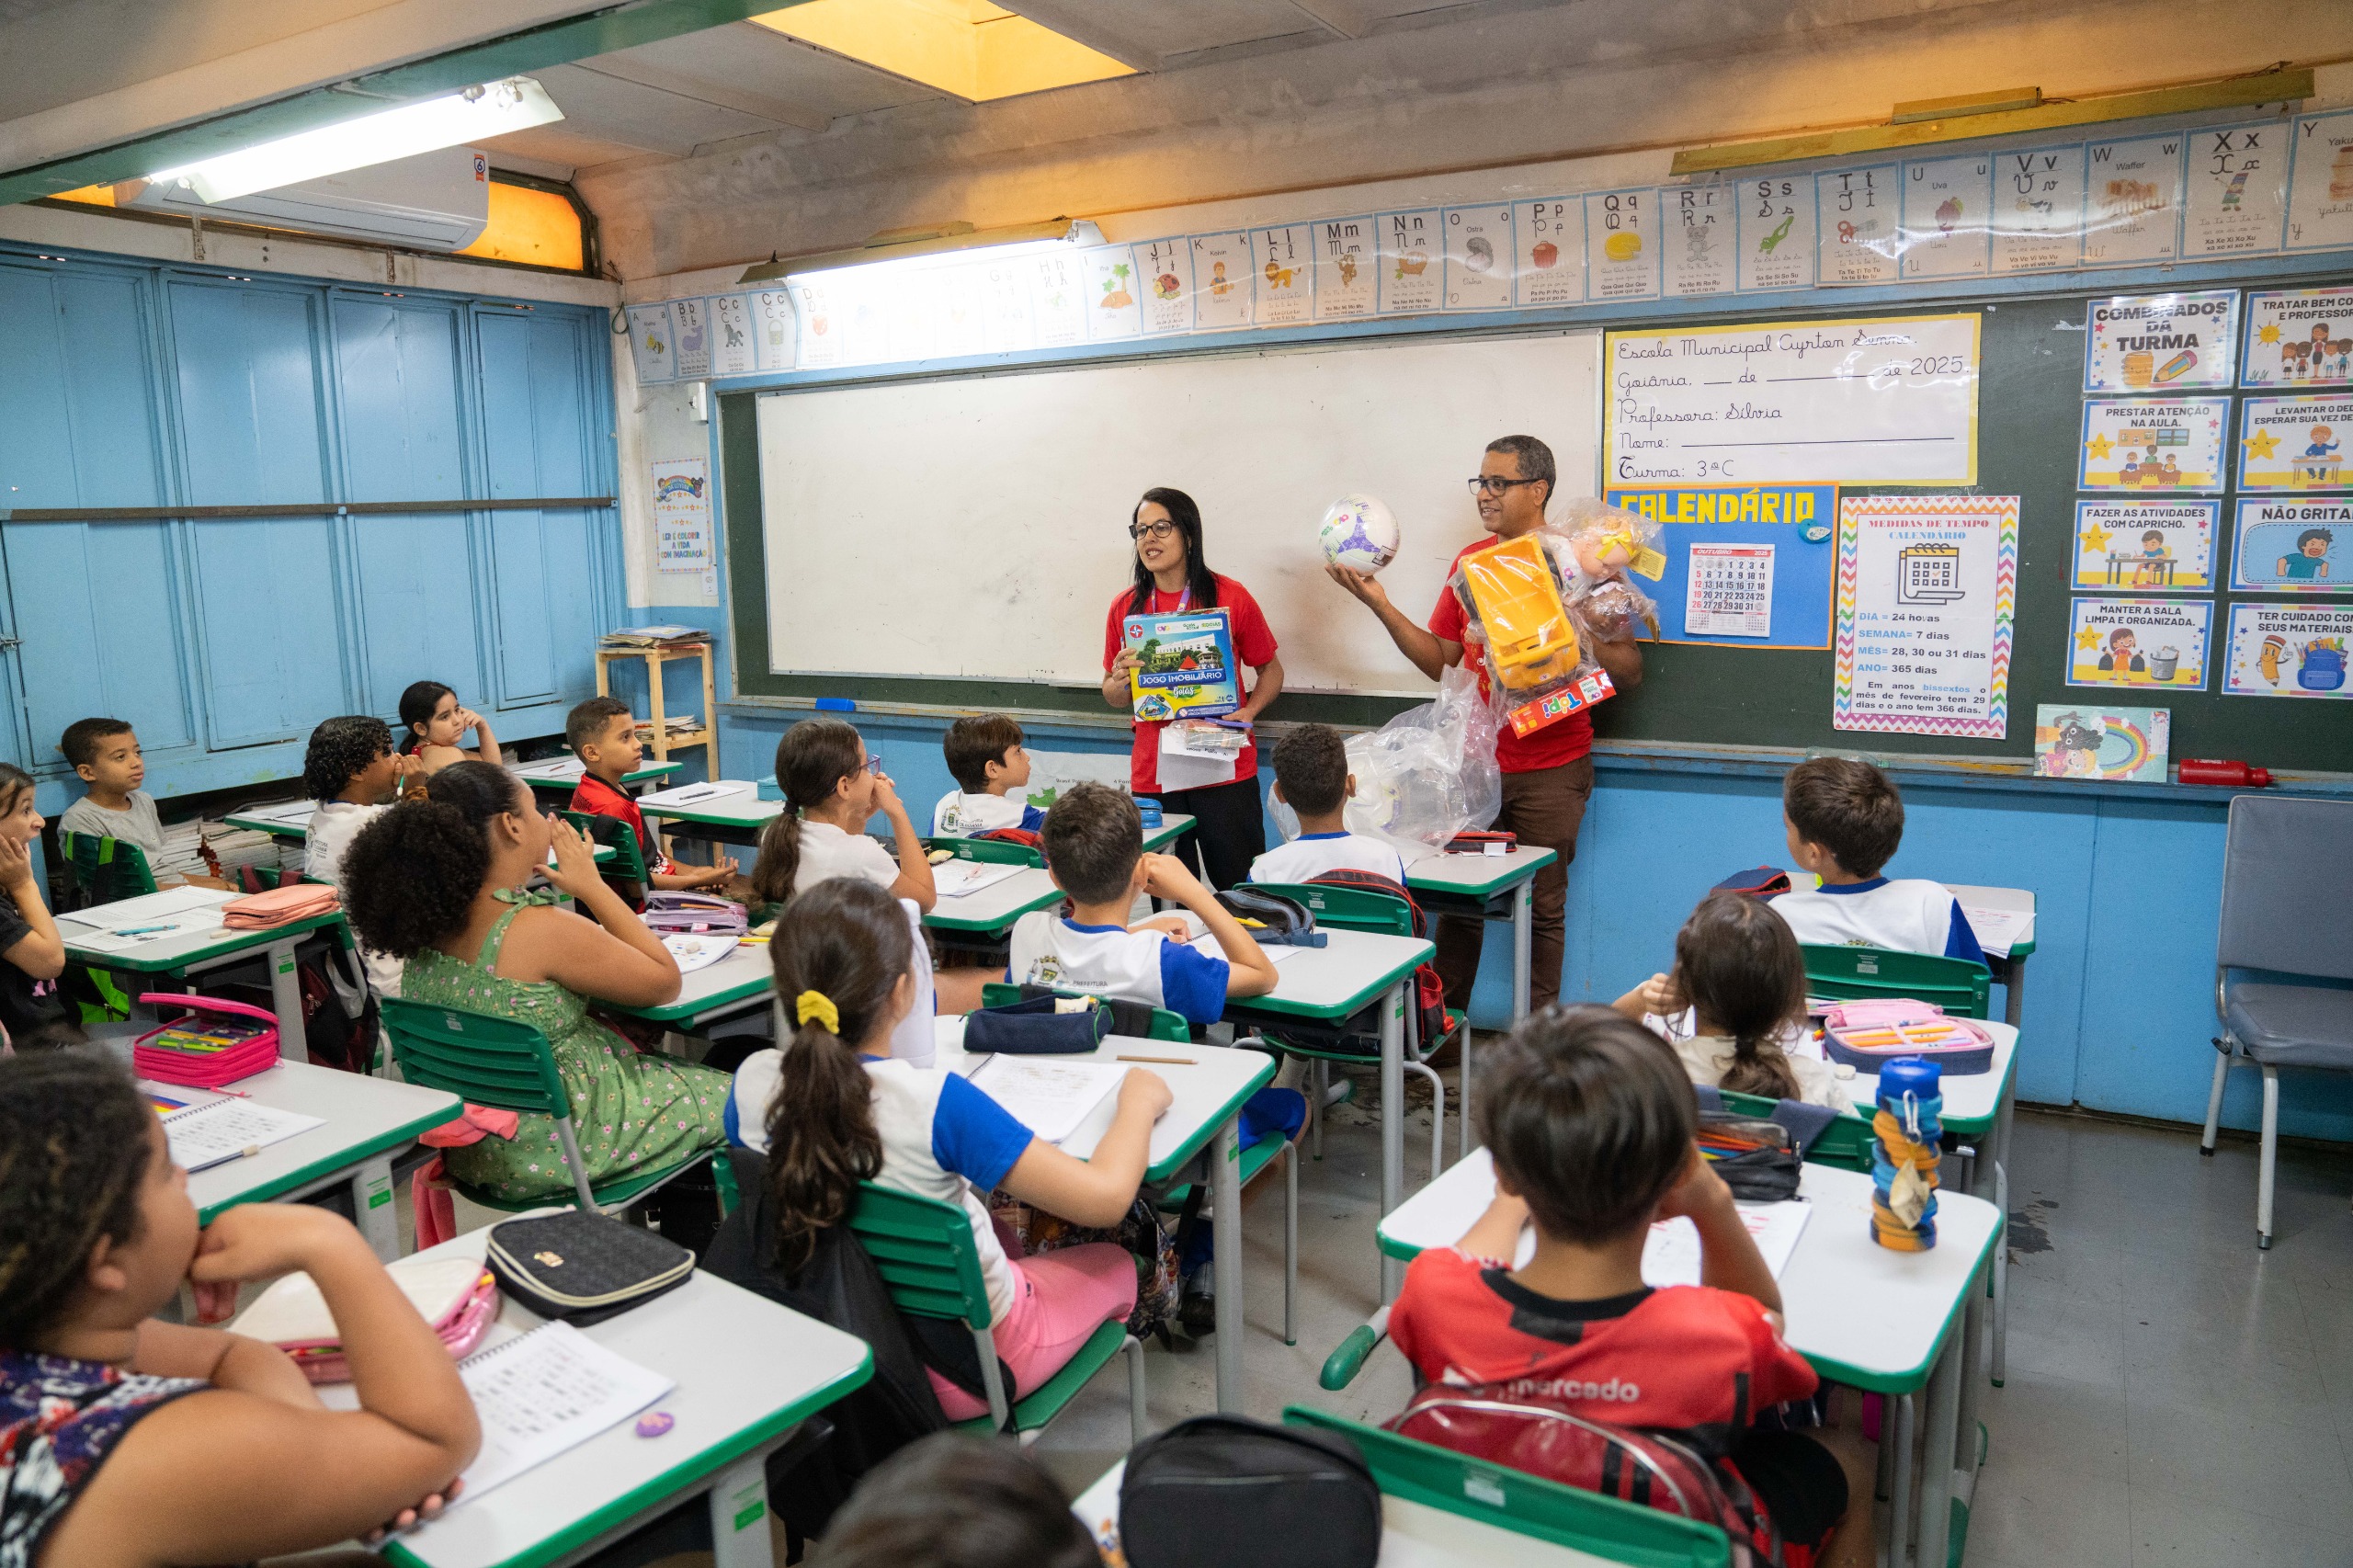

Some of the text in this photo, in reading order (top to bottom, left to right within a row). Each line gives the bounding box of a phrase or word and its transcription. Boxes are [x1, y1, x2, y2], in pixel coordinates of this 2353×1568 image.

[2303, 121, 2318, 138] Y
[2213, 131, 2259, 153] X x
[2093, 143, 2177, 163] W w
[2017, 153, 2057, 172] V v
[2116, 161, 2146, 172] Waffer
[1913, 164, 1986, 181] U u
[1838, 171, 1873, 191] T t
[1932, 182, 1948, 190] Uva
[1758, 181, 1792, 198] S s
[1605, 195, 1637, 211] Q q
[1680, 191, 1713, 207] R r
[1533, 203, 1563, 219] P p
[1393, 215, 1424, 230] N n
[1450, 212, 1508, 225] O o
[1327, 223, 1359, 238] M m
[2263, 300, 2309, 310] TRATAR
[2311, 298, 2336, 308] BEM
[2095, 301, 2229, 322] COMBINADOS
[2279, 312, 2286, 321] E
[2145, 319, 2173, 334] DA
[1619, 343, 1674, 359] Escola
[1681, 335, 1772, 361] Municipal
[2117, 333, 2200, 352] TURMA
[1738, 367, 1757, 384] de
[1883, 359, 1903, 378] de
[1618, 398, 1719, 430] Professora:
[2106, 404, 2211, 417] PRESTAR ATENÇÃO
[2275, 404, 2326, 415] LEVANTAR
[2131, 417, 2182, 428] NA AULA.
[2255, 416, 2297, 425] ESPERAR
[2321, 415, 2339, 423] VEZ
[1619, 432, 1670, 449] Nome:
[1619, 455, 1686, 481] Turma:
[1620, 487, 1814, 524] CALENDÁRIO
[2086, 508, 2206, 518] FAZER AS ATIVIDADES
[2261, 506, 2297, 520] NÃO
[1869, 520, 1990, 528] MEDIDAS DE TEMPO
[2104, 519, 2186, 529] COM CAPRICHO.
[677, 532, 700, 540] COLORIR
[1889, 530, 1966, 540] CALENDÁRIO
[1734, 602, 1744, 610] 30
[2099, 605, 2182, 616] MANTER A SALA
[1892, 613, 1905, 621] 24
[2085, 615, 2196, 627] LIMPA E ORGANIZADA.
[2257, 611, 2281, 621] TER
[2281, 612, 2332, 622] CUIDADO
[2257, 623, 2288, 632] SEUS
[1916, 631, 1923, 639] 7
[1926, 631, 1949, 641] dias
[1892, 647, 1909, 657] 28,
[1912, 648, 1925, 656] 30
[1945, 650, 1959, 658] 31
[1962, 650, 1986, 659] dias
[1892, 665, 1912, 674] 365
[1915, 665, 1938, 675] dias
[1142, 671, 1222, 685] JOGO IMOBILIÁRIO
[1173, 686, 1195, 699] Goiás
[1868, 681, 1883, 689] Em
[1923, 685, 1971, 693] bissextos
[1856, 691, 1876, 699] mês
[1881, 692, 1894, 700] de
[1900, 693, 1941, 702] fevereiro
[1972, 697, 1985, 705] 29
[1856, 701, 1876, 710] dias
[1937, 705, 1955, 713] 366
[1957, 706, 1982, 714] dias.
[1073, 980, 1108, 988] PREFEITURA
